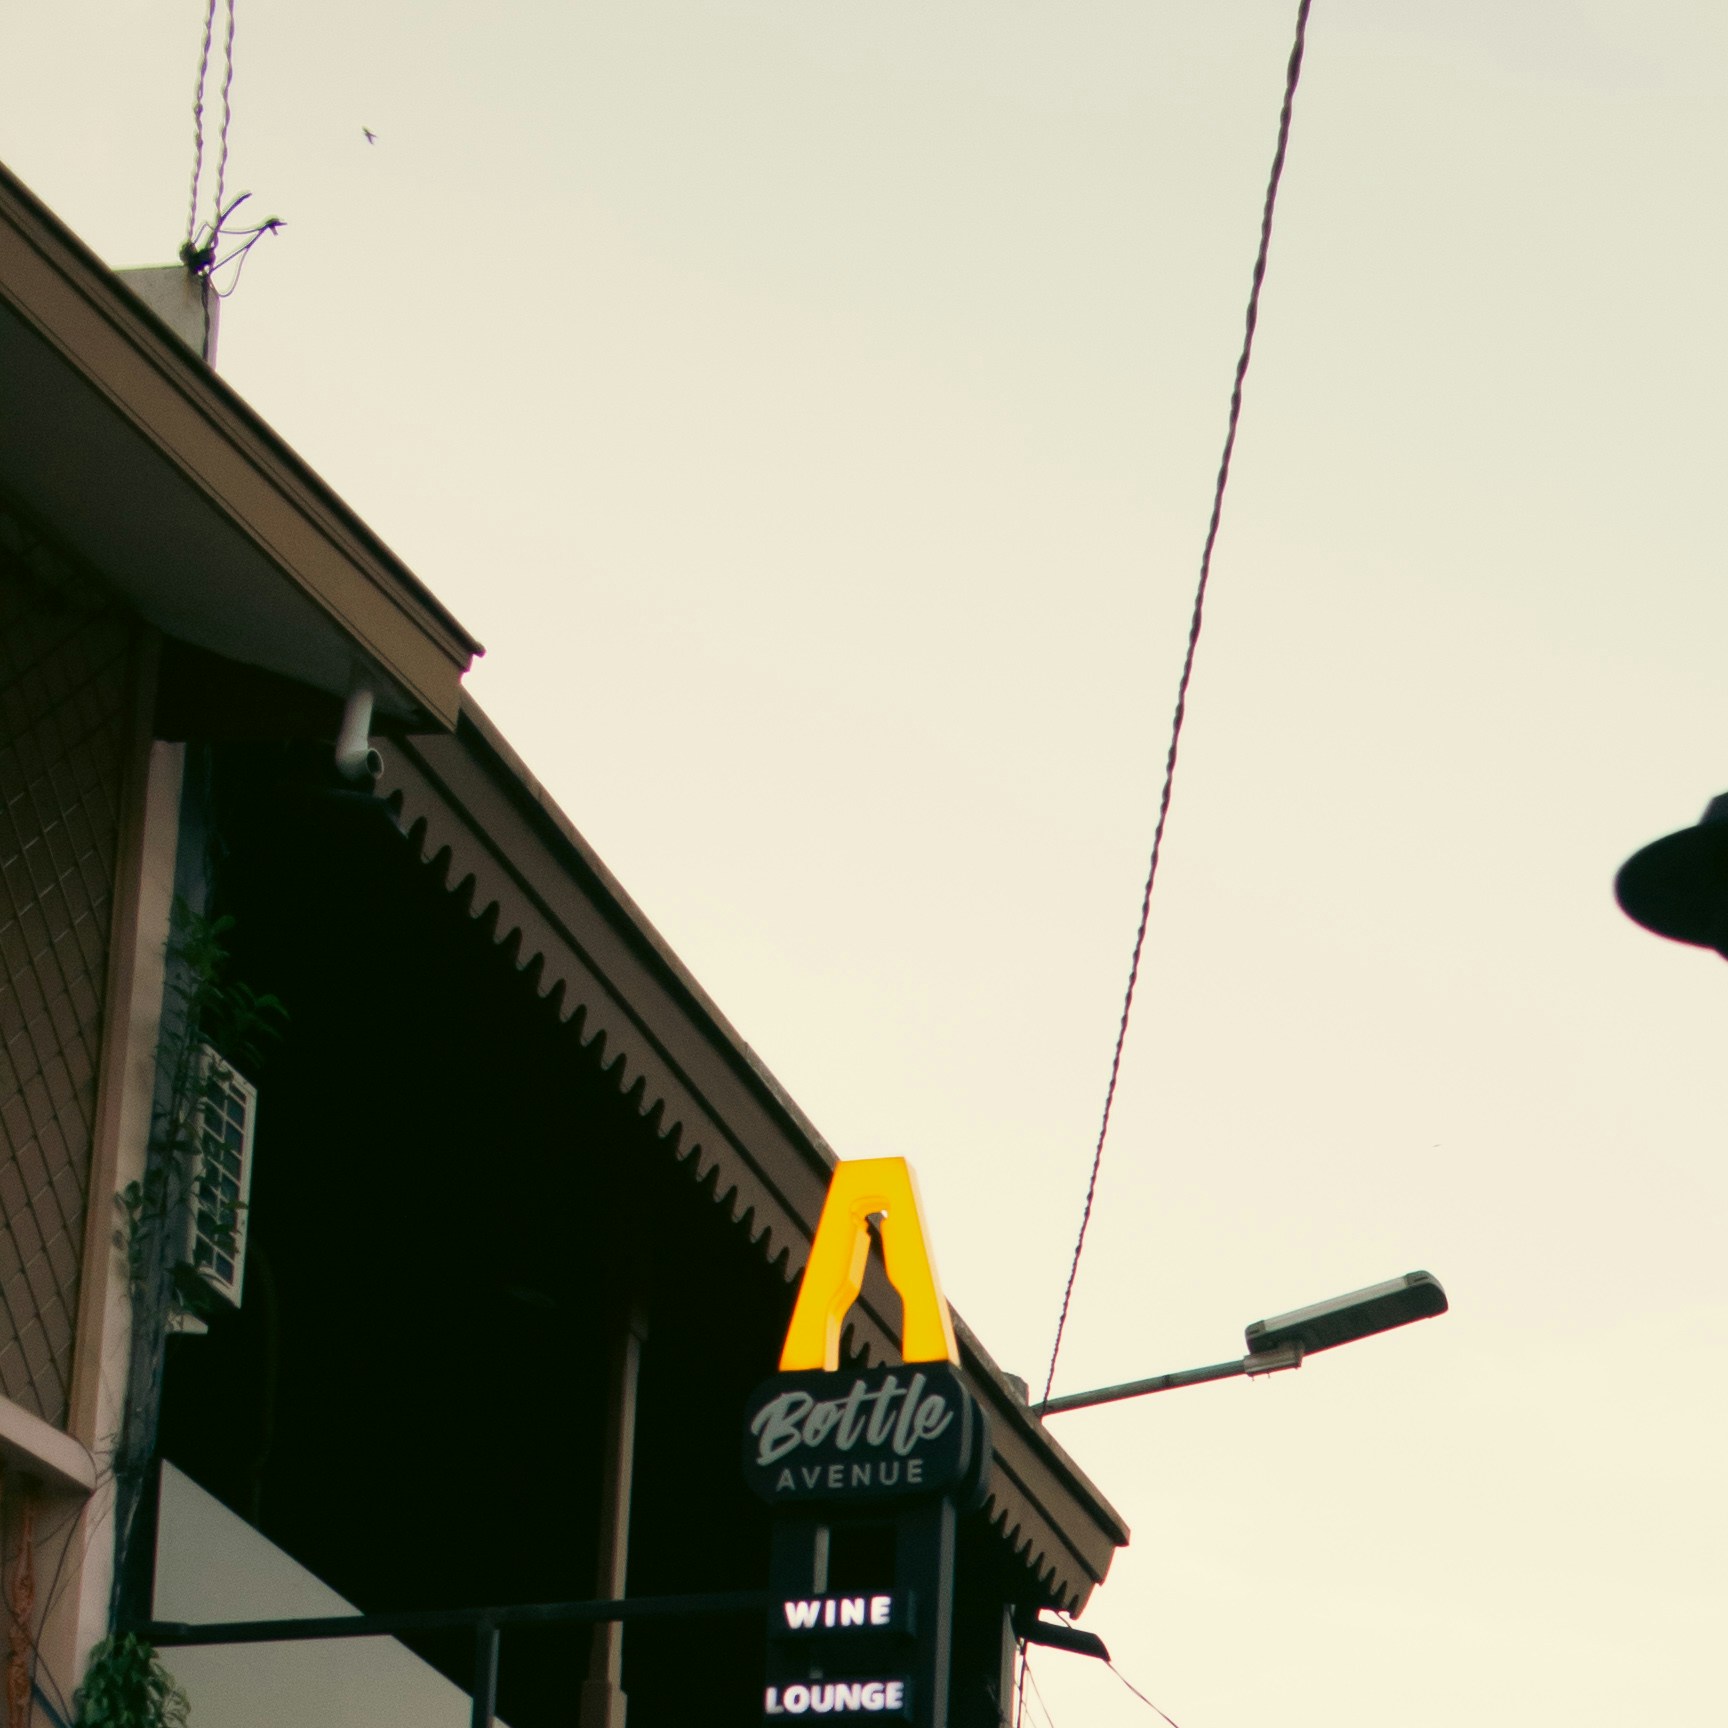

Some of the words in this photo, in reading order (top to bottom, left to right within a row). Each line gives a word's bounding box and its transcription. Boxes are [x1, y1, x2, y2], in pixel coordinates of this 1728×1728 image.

[751, 1373, 953, 1466] Bottle
[775, 1458, 924, 1492] AVENUE
[784, 1596, 892, 1630] WINE
[765, 1681, 905, 1715] LOUNGE
